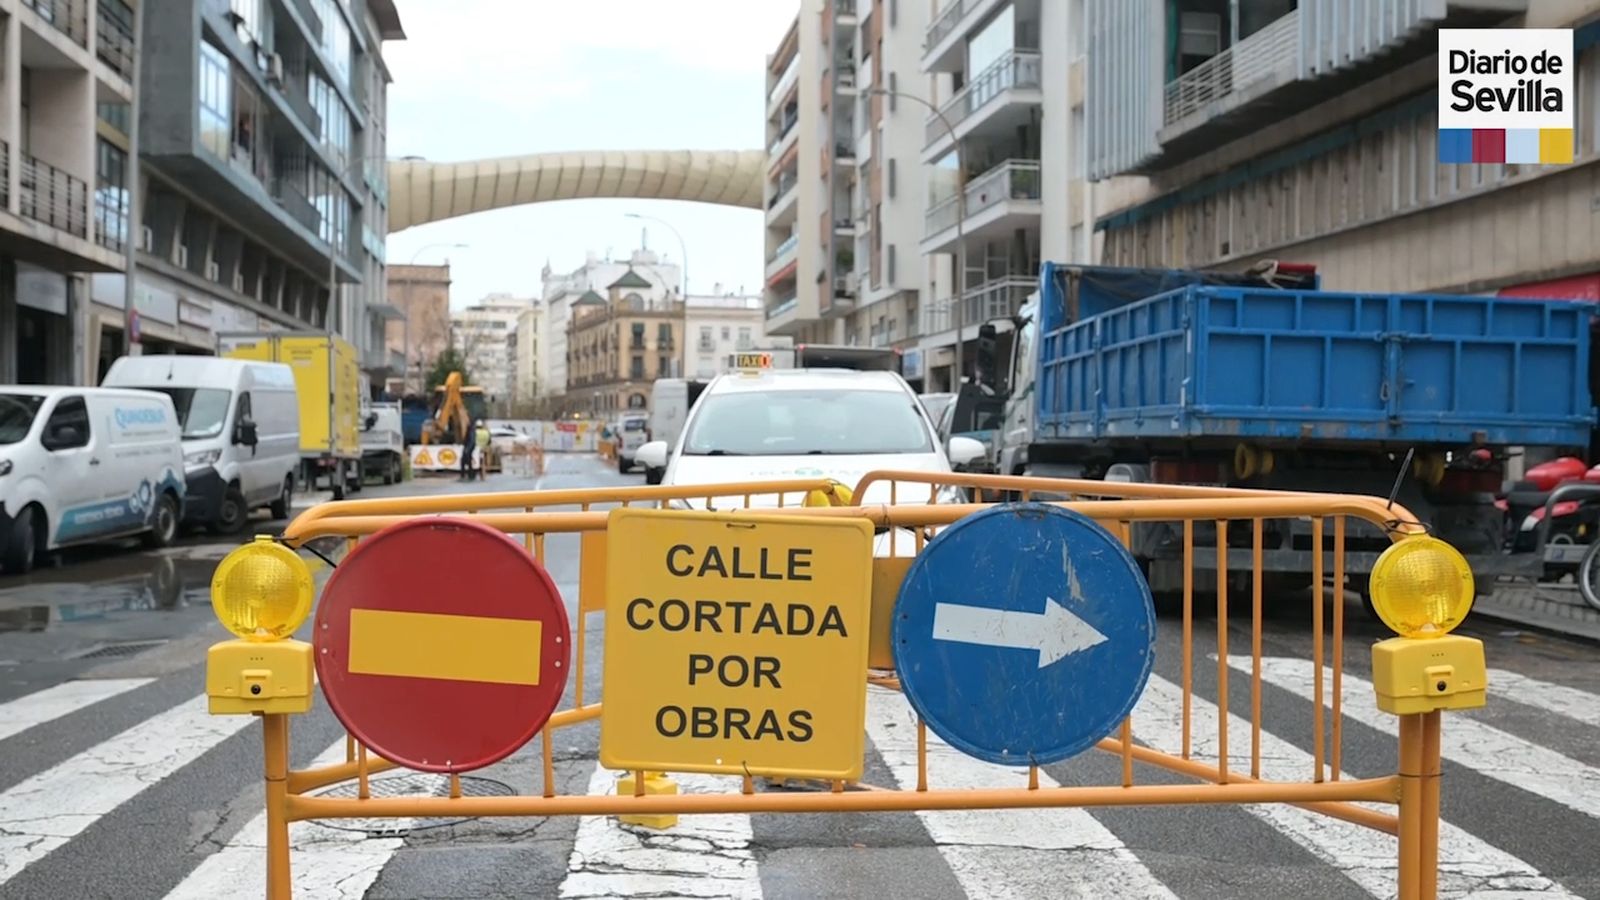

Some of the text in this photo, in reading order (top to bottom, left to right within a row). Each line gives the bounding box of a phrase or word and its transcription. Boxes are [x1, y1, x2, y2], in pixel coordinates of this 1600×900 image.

[738, 354, 761, 368] TAXI
[665, 544, 813, 582] CALLE
[626, 597, 848, 638] CORTADA
[688, 653, 782, 689] POR
[655, 705, 814, 743] OBRAS
